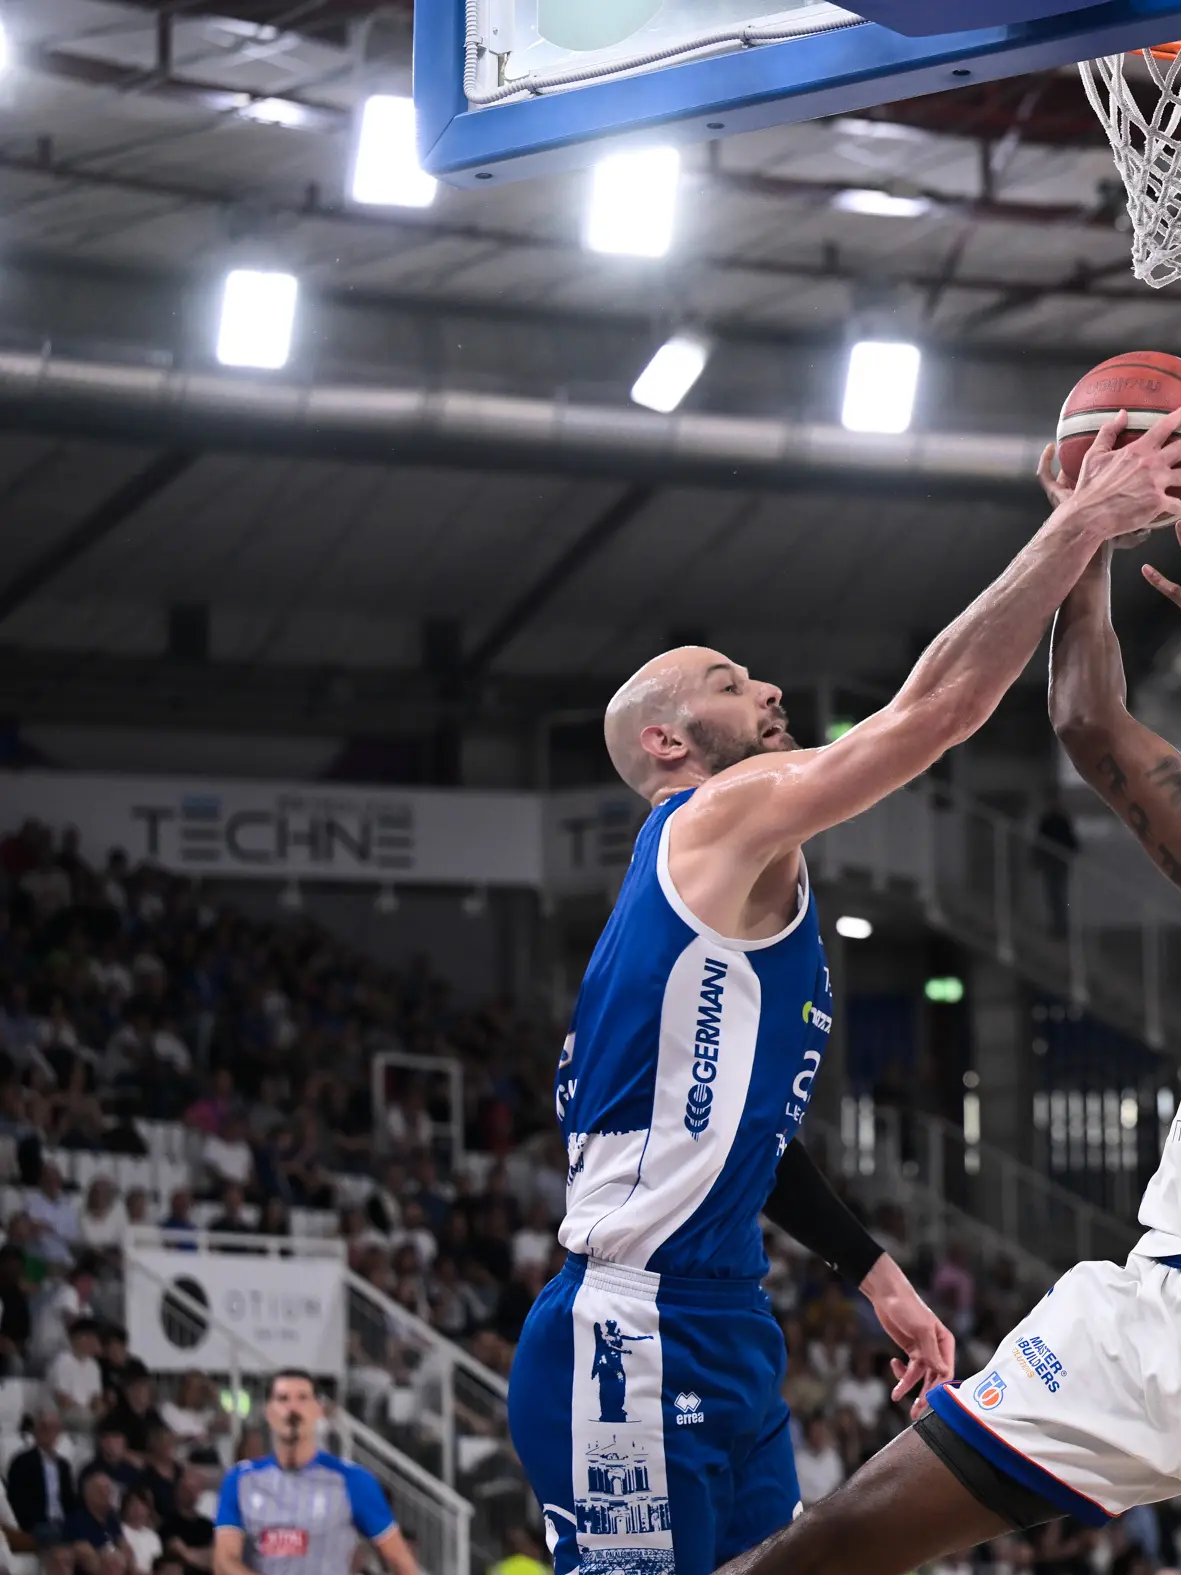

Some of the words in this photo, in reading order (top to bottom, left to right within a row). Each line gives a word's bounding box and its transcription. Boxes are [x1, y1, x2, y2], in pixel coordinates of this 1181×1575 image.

[691, 957, 728, 1084] GERMANI
[1017, 1339, 1060, 1394] BUILDERS
[1029, 1335, 1063, 1375] MASTER
